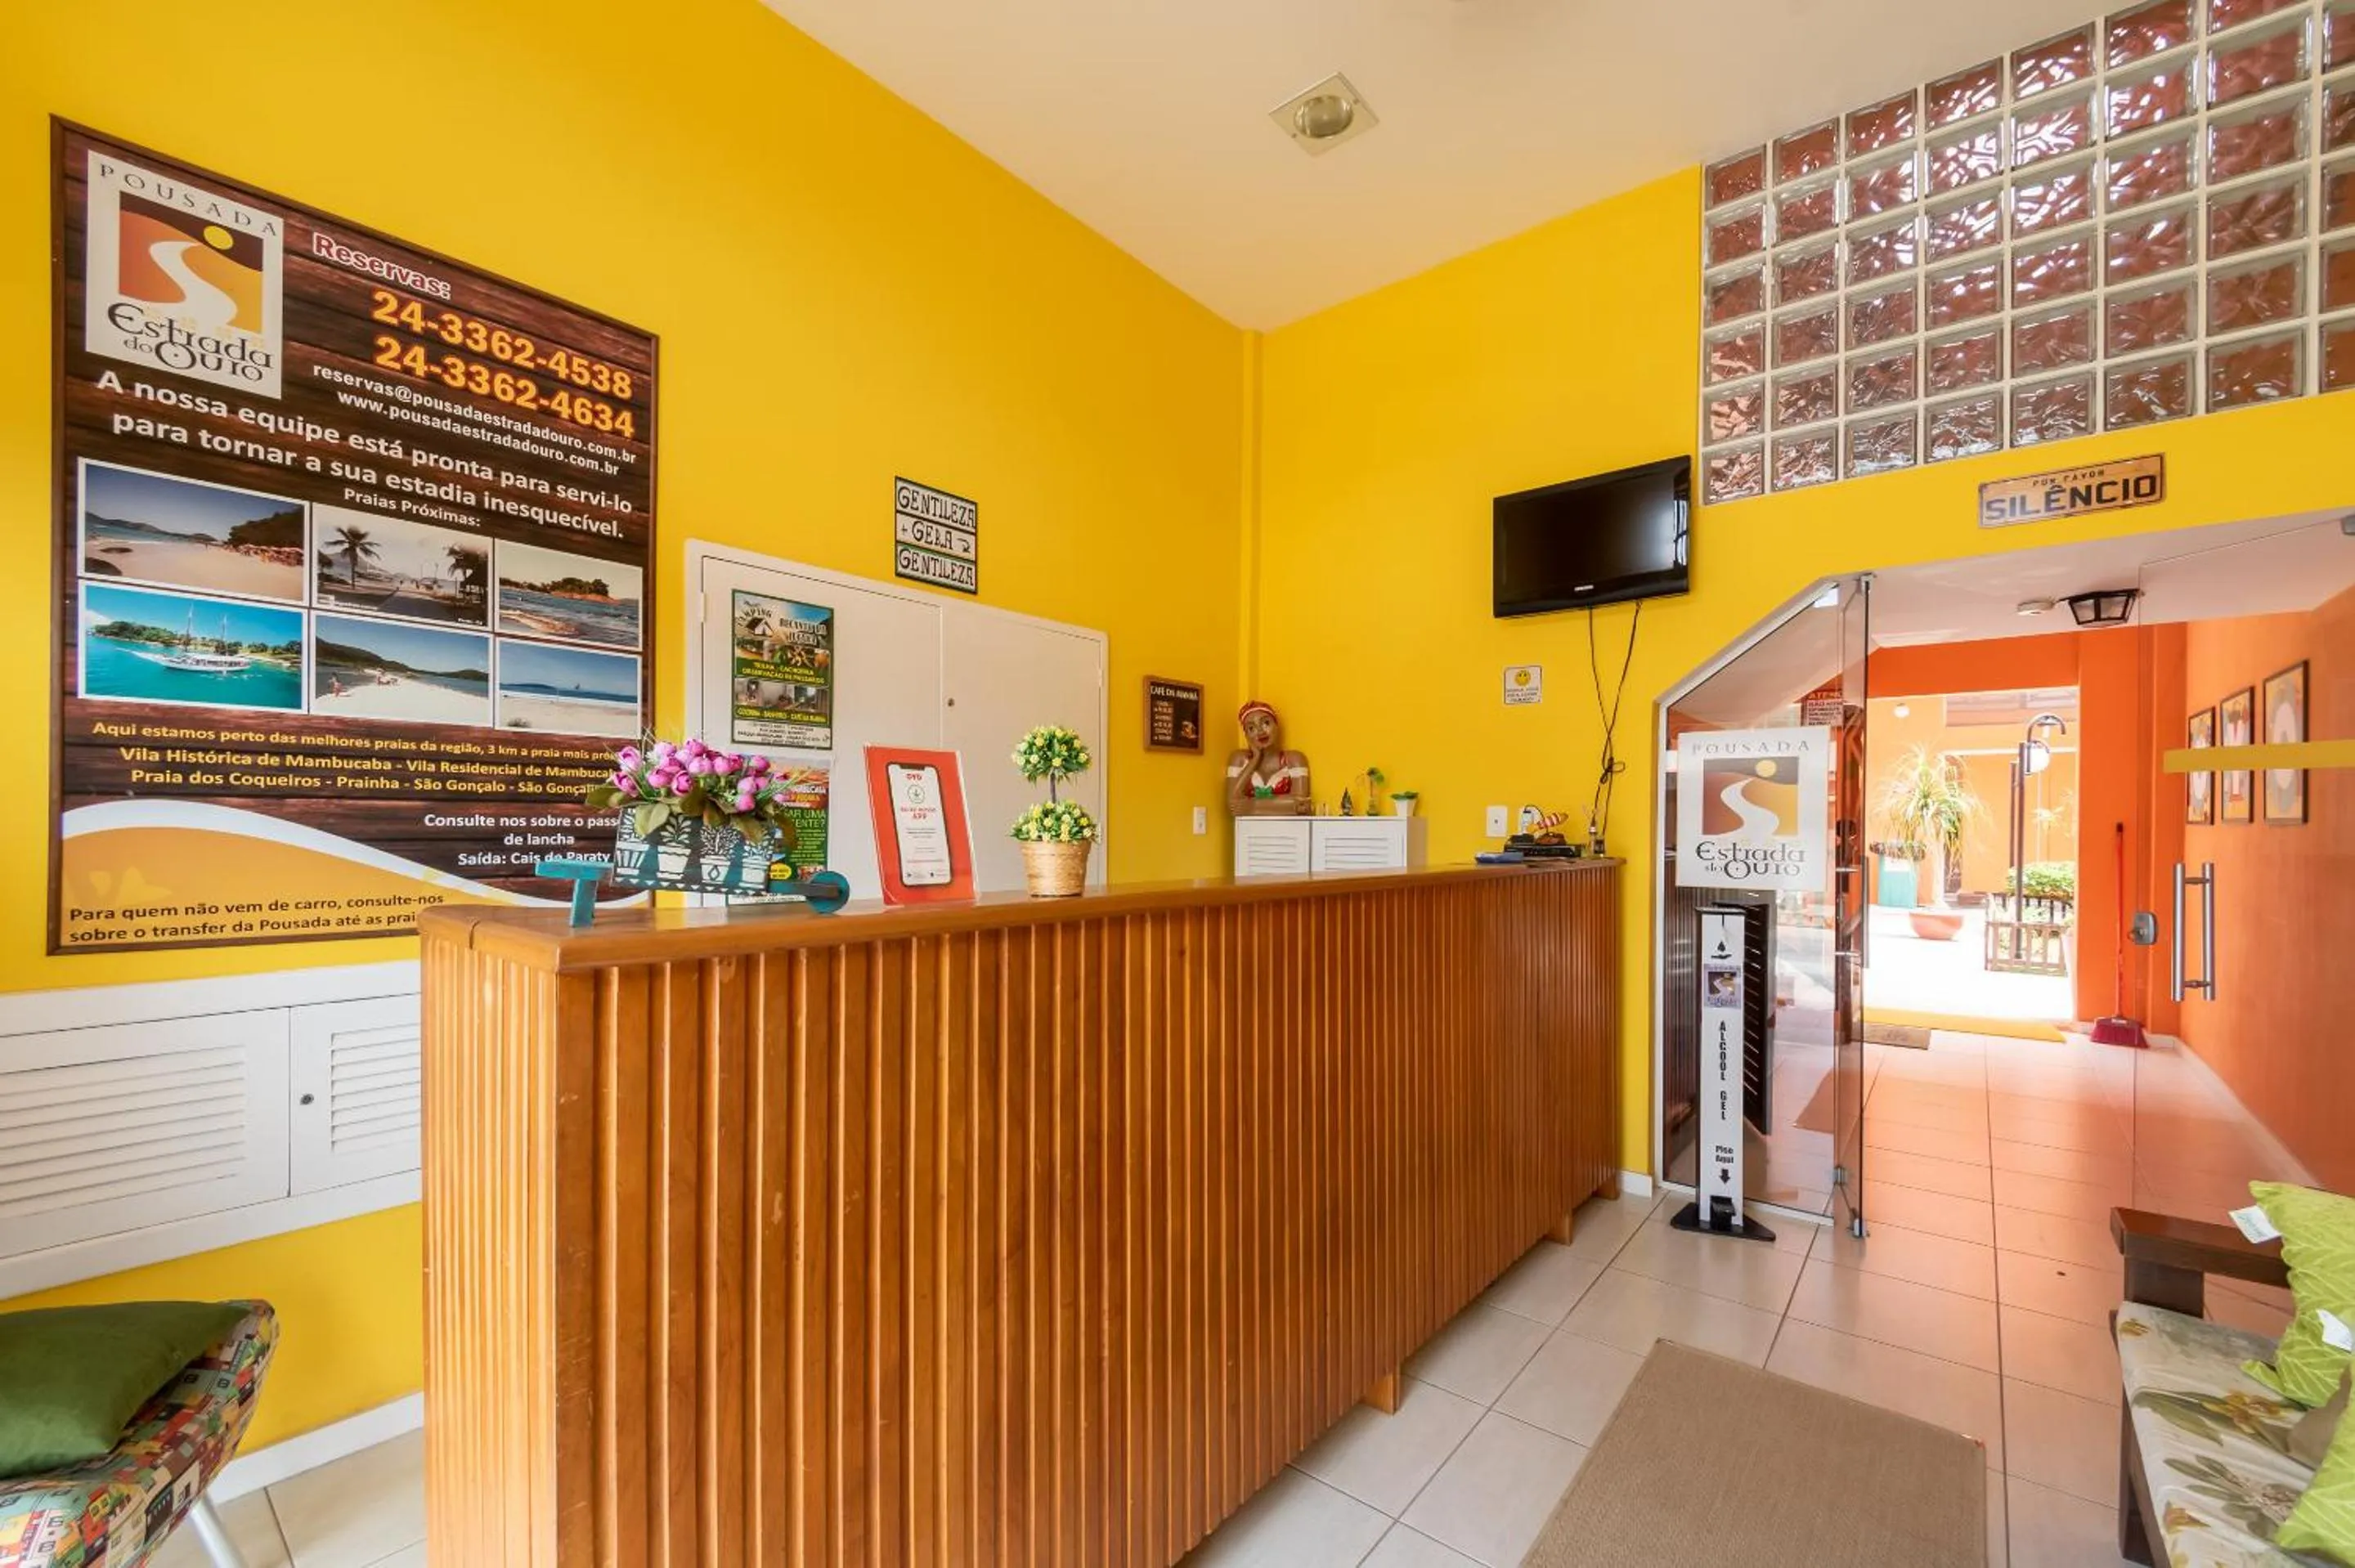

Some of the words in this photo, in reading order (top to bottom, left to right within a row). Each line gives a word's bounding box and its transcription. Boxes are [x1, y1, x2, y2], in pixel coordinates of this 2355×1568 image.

[99, 164, 277, 237] POUSADA
[312, 231, 452, 301] Reservas:
[107, 301, 275, 369] Estrada
[370, 288, 634, 401] 24-3362-4538
[123, 335, 154, 355] do
[155, 340, 264, 383] Ouro
[372, 334, 636, 441] 24-3362-4634
[312, 363, 638, 464] reservas@pousadaestradadouro.com.br
[337, 391, 620, 477] www.pousadaestradadouro.com.br
[96, 370, 123, 393] A
[134, 381, 228, 419] nossa
[237, 406, 341, 444] equipe
[348, 433, 404, 459] está
[411, 448, 494, 482] pronta
[500, 470, 551, 495] para
[556, 483, 633, 514] servi-lo
[112, 413, 189, 444] para
[198, 428, 298, 466] tornar
[304, 455, 322, 473] a
[330, 459, 378, 486] sua
[384, 472, 478, 508] estadia
[482, 491, 625, 540] inesquecível.
[2032, 477, 2057, 487] POR
[2063, 468, 2106, 484] FAVOR
[343, 487, 397, 510] Praias
[401, 500, 482, 528] Próximas:
[897, 485, 976, 528] GENTILEZA
[1984, 474, 2157, 521] SILÊNCIO
[899, 547, 974, 586] GENTILEZA
[92, 720, 137, 737] Aqui
[141, 725, 216, 741] estamos
[220, 729, 266, 743] perto
[268, 731, 297, 745] das
[300, 733, 370, 750] melhores
[374, 738, 417, 753] praias
[419, 740, 437, 752] da
[440, 742, 485, 756] região,
[487, 744, 496, 755] 3
[497, 745, 518, 757] km
[519, 747, 529, 757] a
[531, 746, 561, 760] praia
[562, 747, 590, 761] mais
[1692, 739, 1810, 755] POUSADA
[119, 746, 160, 763] Vila
[166, 748, 253, 766] Histórica
[256, 752, 280, 767] de
[285, 754, 392, 771] Mambucaba
[406, 759, 437, 773] Vila
[440, 761, 523, 776] Residencial
[524, 764, 543, 777] de
[131, 769, 183, 785] Praia
[188, 770, 223, 785] dos
[228, 771, 321, 789] Coqueiros
[336, 776, 400, 790] Prainha
[414, 777, 442, 791] São
[446, 779, 506, 794] Gonçalo
[518, 780, 543, 793] São
[424, 813, 496, 828] Consulte
[499, 816, 527, 827] nos
[530, 814, 572, 827] sobre
[574, 816, 585, 827] o
[587, 816, 619, 830] pass
[503, 832, 524, 845] de
[527, 832, 576, 845] lancha
[457, 851, 507, 866] Saída:
[509, 851, 541, 864] Cais
[1695, 840, 1807, 863] Estrada
[1723, 859, 1801, 880] Ouro
[69, 907, 116, 922] Para
[121, 905, 179, 920] quem
[183, 902, 220, 916] não
[224, 903, 264, 915] vem
[267, 898, 290, 912] de
[294, 898, 342, 912] carro,
[346, 893, 445, 909] consulte-nos
[69, 927, 128, 943] sobre
[133, 926, 146, 939] o
[151, 922, 227, 938] transfer
[231, 920, 254, 934] da
[258, 916, 332, 931] Pousada
[336, 912, 362, 927] até
[365, 915, 383, 926] as
[386, 911, 416, 929] prai
